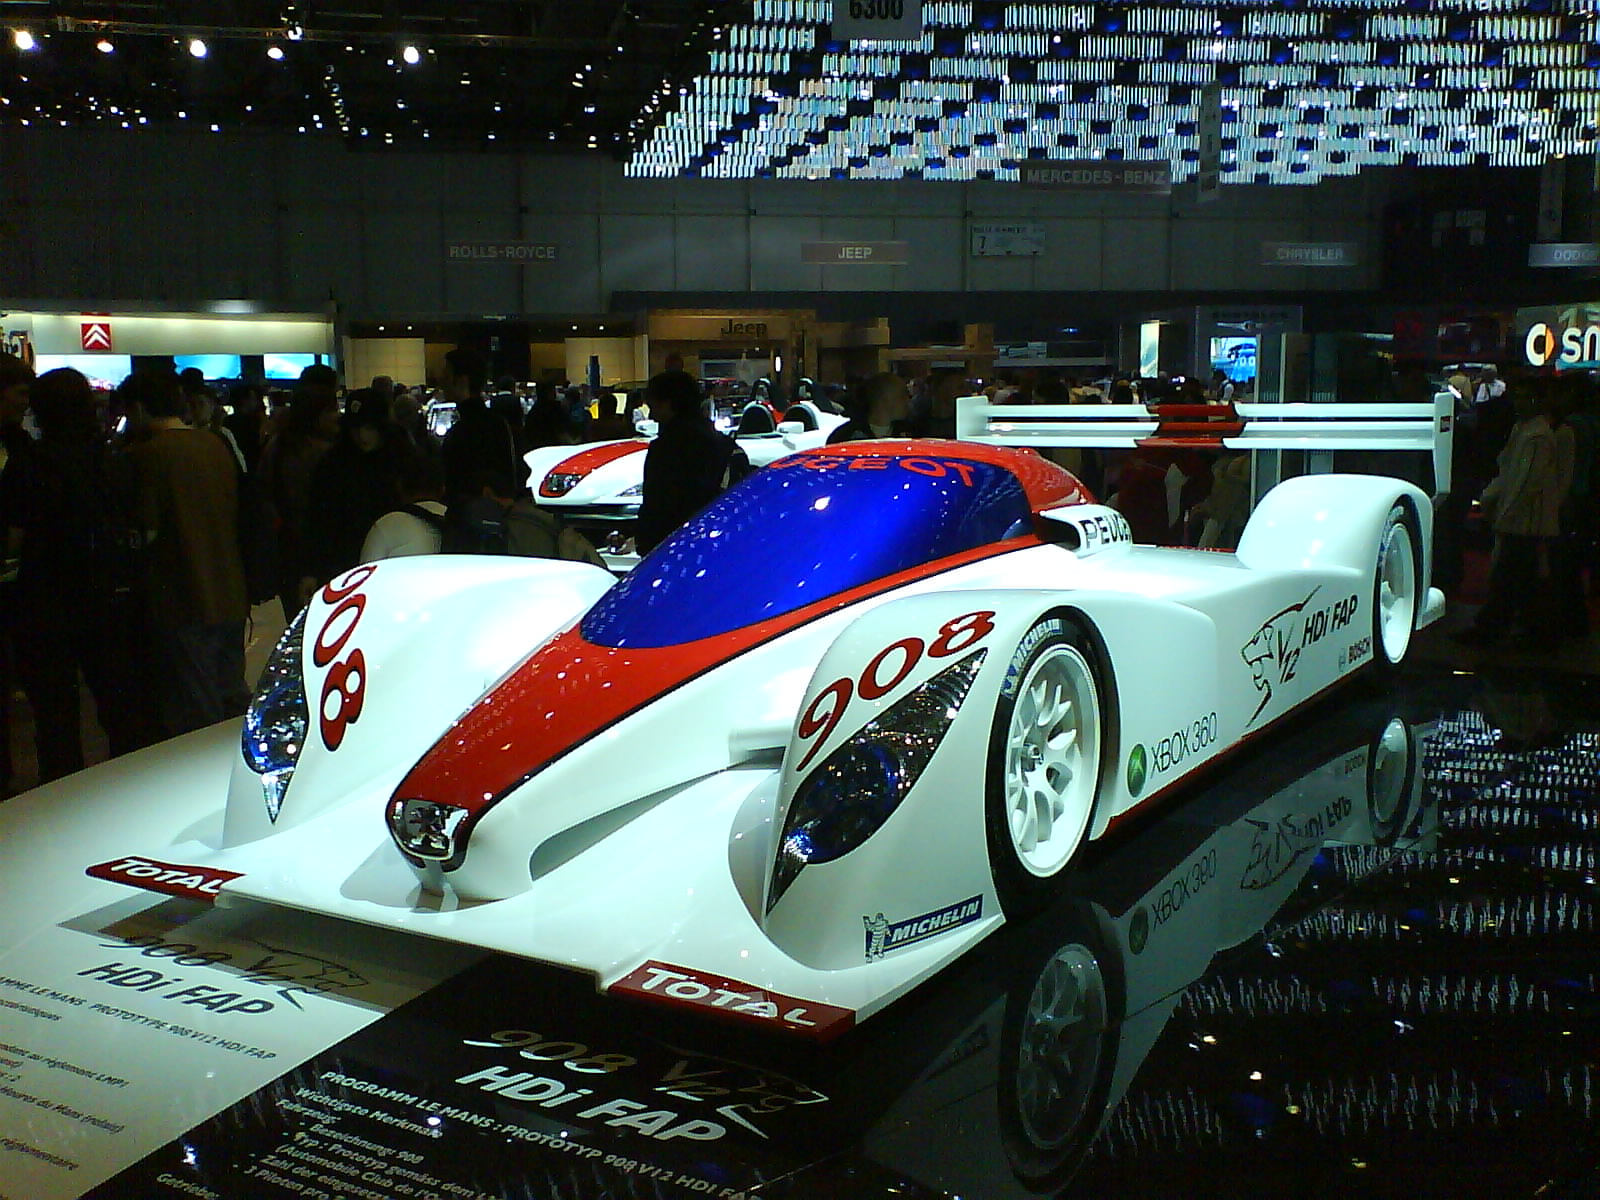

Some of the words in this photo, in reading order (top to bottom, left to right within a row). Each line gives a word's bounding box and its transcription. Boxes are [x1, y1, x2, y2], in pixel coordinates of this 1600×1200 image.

[849, 0, 904, 20] 6300
[449, 245, 556, 260] ROLLS-ROYCE
[837, 246, 873, 260] JEEP
[720, 318, 768, 337] Jeep
[1301, 606, 1331, 648] HDi
[1330, 594, 1359, 633] FAP
[313, 565, 378, 752] 908
[797, 610, 997, 772] 908
[1150, 724, 1192, 779] XBOX
[1191, 711, 1218, 753] 360
[110, 858, 224, 894] TOTAL
[890, 899, 981, 945] MICHELIN
[76, 962, 184, 992] HDi
[162, 984, 276, 1014] FAP
[638, 966, 817, 1027] TOTAL
[88, 1003, 168, 1030] PROTOTYPE
[243, 1047, 277, 1060] FAP
[462, 1029, 638, 1074] 908
[295, 1086, 370, 1118] Wichtigste
[319, 1070, 419, 1106] PROGRAMM
[415, 1098, 443, 1113] LE
[439, 1105, 494, 1129] MANS
[501, 1123, 603, 1159] PROTOTYP
[602, 1153, 638, 1173] 908
[637, 1162, 675, 1183] V12
[454, 1065, 594, 1109] HDi
[575, 1098, 727, 1141] FAP
[360, 1170, 395, 1188] Club
